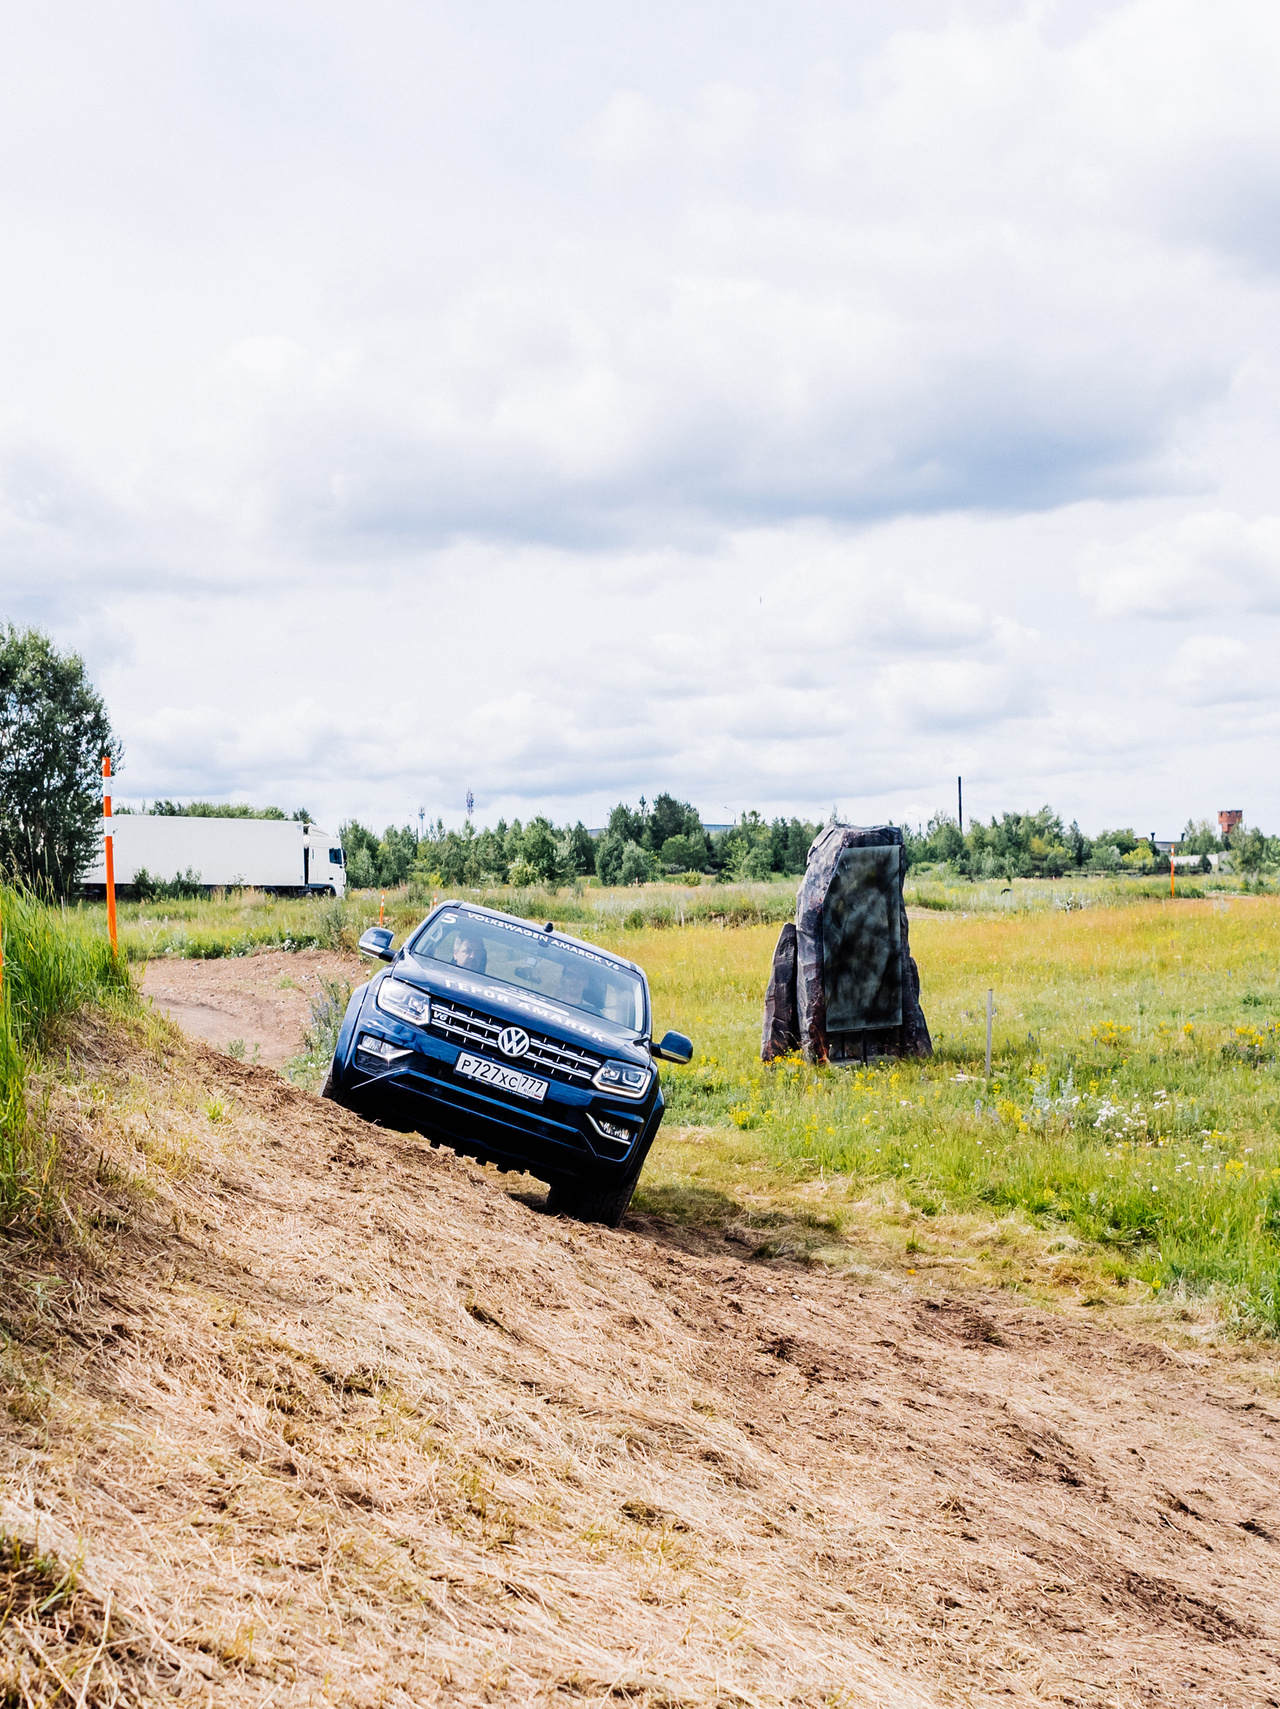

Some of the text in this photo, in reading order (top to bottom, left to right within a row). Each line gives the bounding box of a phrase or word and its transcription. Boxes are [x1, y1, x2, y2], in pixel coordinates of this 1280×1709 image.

[441, 912, 459, 924] 5
[467, 912, 620, 971] VOLKSWAGEN AMAROK V6
[433, 1011, 449, 1021] V6
[521, 1076, 544, 1093] 777
